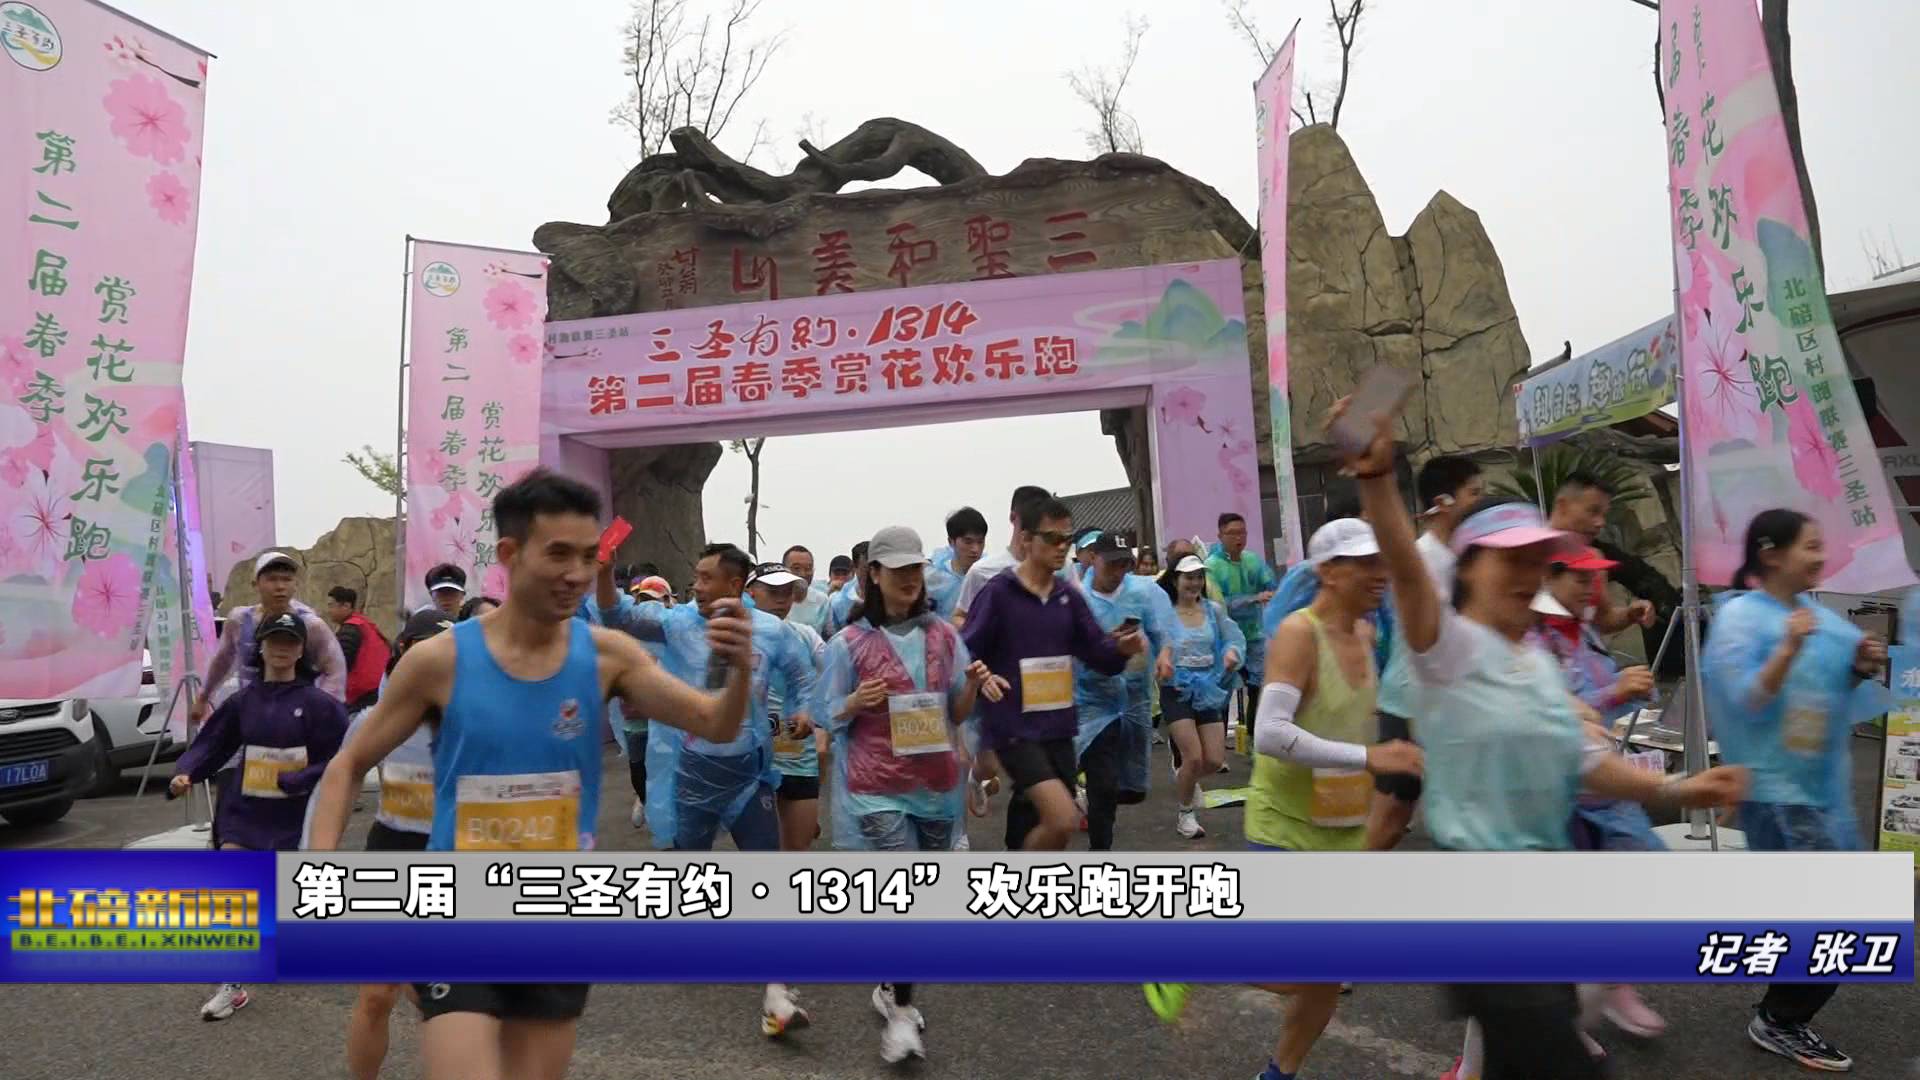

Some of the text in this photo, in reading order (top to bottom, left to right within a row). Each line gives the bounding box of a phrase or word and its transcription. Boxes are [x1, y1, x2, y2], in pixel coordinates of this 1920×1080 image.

[20, 130, 79, 423] 第二届春季
[63, 275, 136, 561] 赏花欢乐跑
[440, 327, 471, 492] 第二届春季
[588, 336, 1079, 416] 第二届春季赏花欢乐跑
[467, 816, 555, 843] B0242
